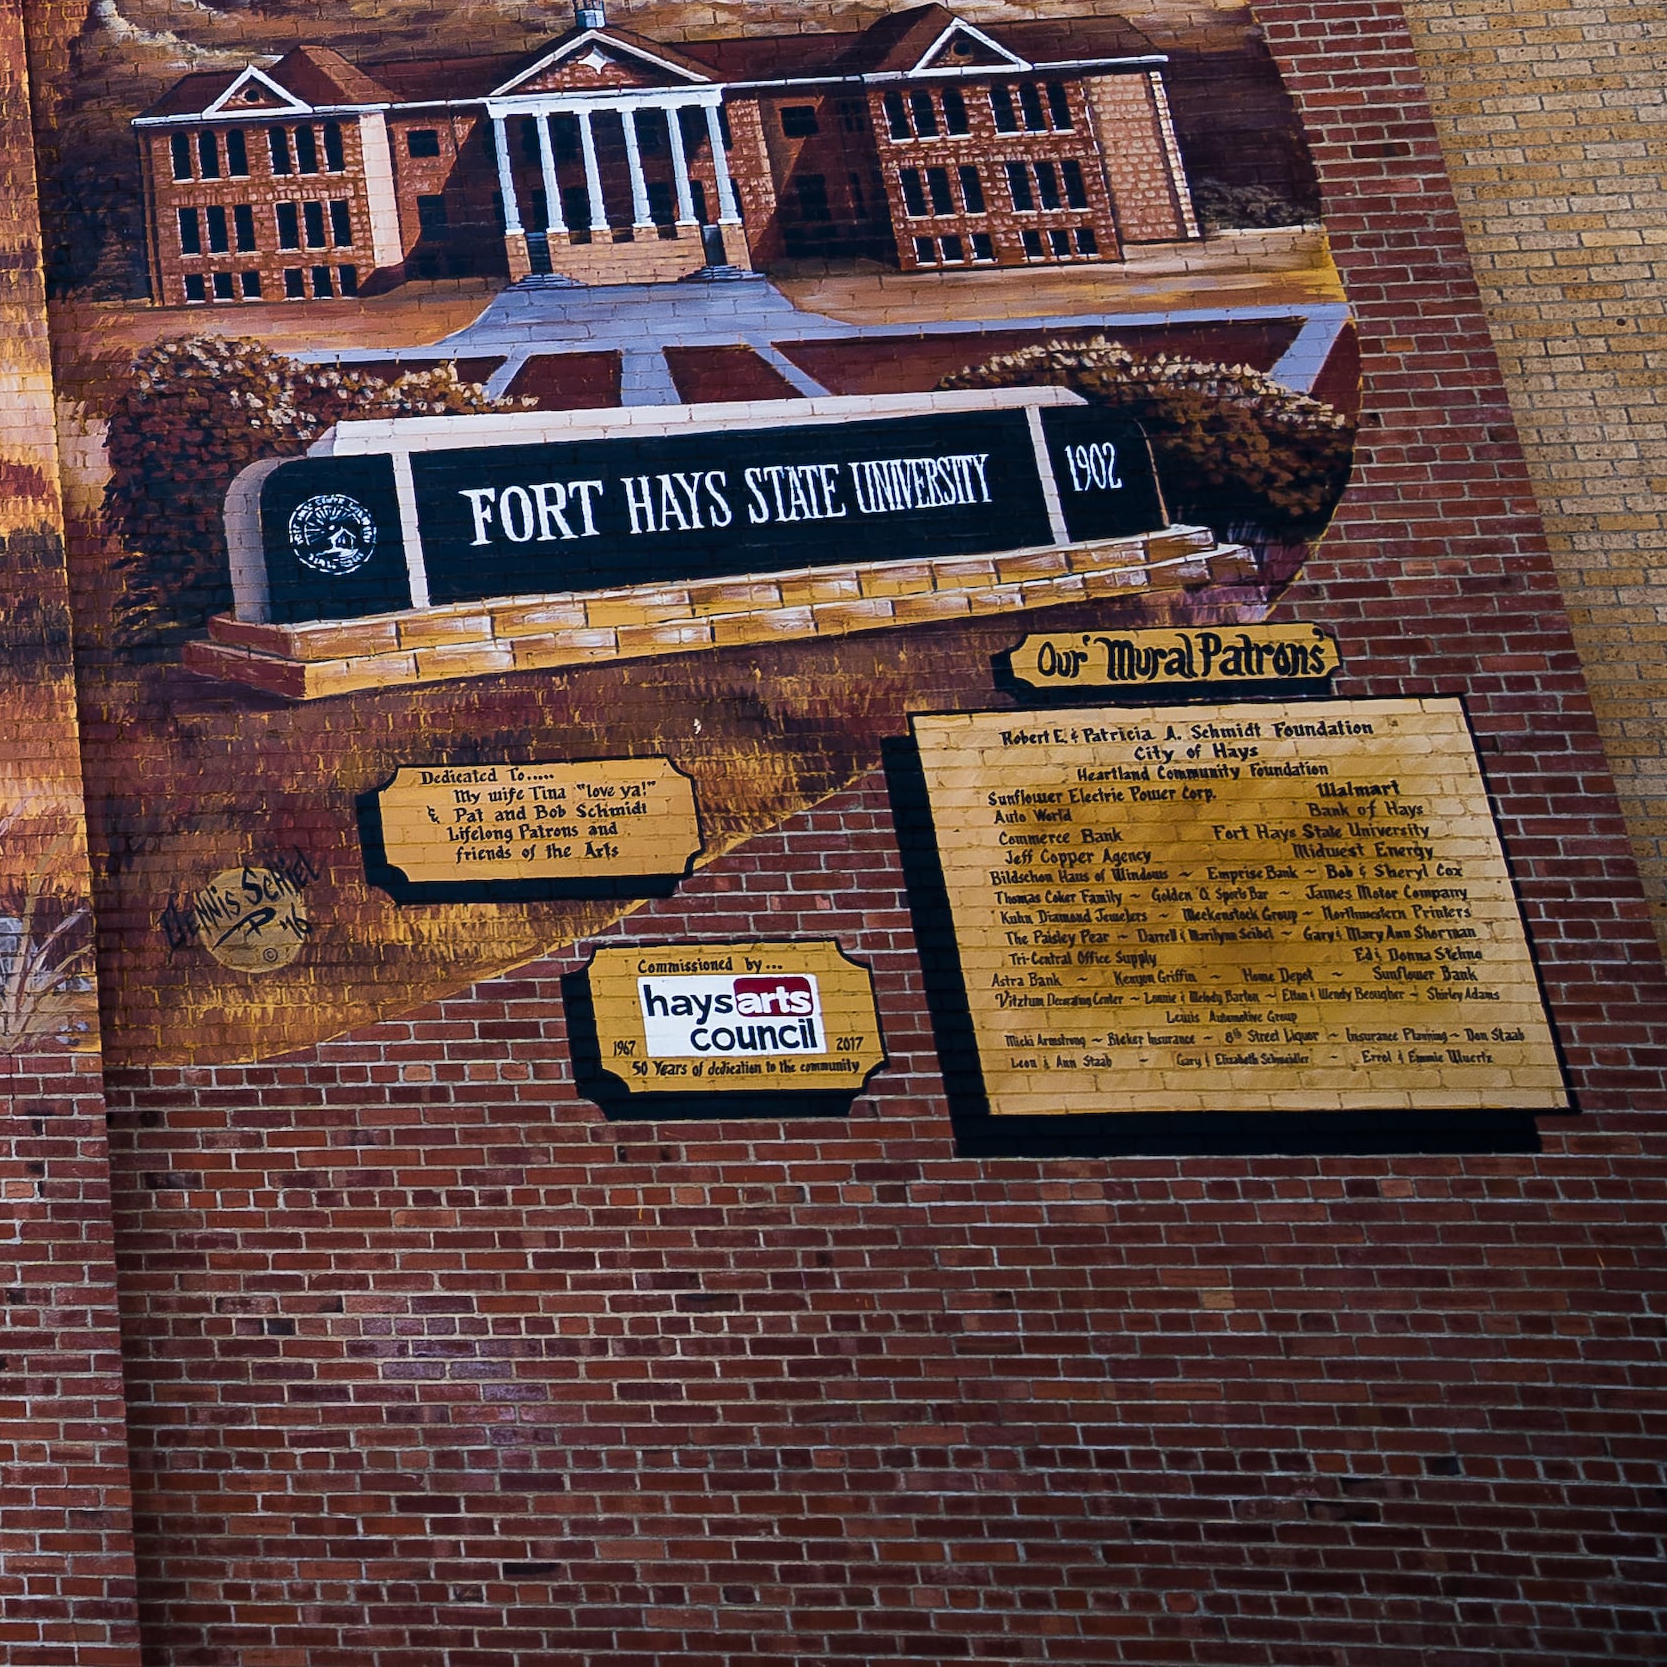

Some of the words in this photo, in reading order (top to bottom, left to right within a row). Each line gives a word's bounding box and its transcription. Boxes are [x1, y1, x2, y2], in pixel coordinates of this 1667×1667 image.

[1063, 441, 1123, 494] 1902
[460, 478, 604, 548] FORT
[618, 471, 733, 536] HAYS
[743, 466, 848, 524] STATE
[852, 453, 995, 515] UNIVERSITY
[1038, 641, 1089, 678] Our
[999, 730, 1050, 745] Robert
[1082, 727, 1156, 742] Patricia
[1163, 726, 1181, 741] A.
[1190, 723, 1261, 739] Schmidt
[1271, 721, 1374, 738] Foundation
[1134, 746, 1174, 764] City
[1187, 744, 1202, 758] of
[1213, 743, 1258, 761] Hays
[419, 769, 498, 785] Dedicated
[1078, 767, 1150, 782] Heartland
[1157, 765, 1239, 780] Community
[1250, 763, 1329, 778] Foundation
[453, 789, 481, 804] My
[488, 788, 524, 805] wife
[530, 786, 567, 800] Tina
[988, 789, 1064, 806] Sunflower
[1068, 788, 1124, 804] Electric
[1128, 786, 1176, 802] Power
[1182, 786, 1216, 803] Corp.
[1316, 781, 1400, 797] Walmart
[453, 807, 484, 823] Pat
[495, 805, 527, 821] and
[535, 805, 566, 819] Bob
[576, 801, 647, 818] Schmidt
[994, 810, 1026, 824] Auto
[1033, 809, 1072, 822] World
[1307, 802, 1349, 817] Bank
[1357, 800, 1377, 819] of
[1385, 802, 1424, 819] Hays
[446, 825, 513, 844] Lifelong
[518, 823, 579, 840] Patrons
[588, 822, 618, 835] and
[998, 832, 1070, 845] Commerce
[1081, 827, 1123, 843] Bank
[1211, 825, 1249, 840] Fort
[1254, 824, 1296, 842] Hays
[1302, 824, 1342, 839] State
[1348, 823, 1430, 838] University
[455, 844, 511, 864] friends
[521, 844, 537, 861] of
[546, 842, 572, 857] the
[585, 841, 619, 860] Arts
[1005, 849, 1033, 865] Jeff
[1040, 849, 1094, 868] Copper
[1102, 849, 1151, 867] Agency
[1292, 843, 1365, 859] Midwest
[1374, 841, 1433, 861] Energy
[1095, 869, 1105, 882] of
[1111, 867, 1168, 882] Windows
[1208, 866, 1263, 883] Emprise
[1266, 865, 1298, 879] Bank
[1325, 864, 1353, 879] Bob
[1374, 864, 1428, 881] Sheryl
[1436, 863, 1463, 877] Cox
[994, 891, 1040, 905] Thomas
[1079, 889, 1122, 906] Family
[1151, 887, 1192, 904] Golden
[1249, 886, 1268, 900] Bar
[1305, 885, 1352, 900] James
[1356, 885, 1398, 900] Motor
[1403, 884, 1467, 901] Company
[1001, 911, 1033, 925] Kuhn
[1036, 909, 1091, 924] Diamond
[1095, 908, 1148, 923] Jewelers
[1262, 909, 1298, 923] Group
[1322, 908, 1406, 921] Northwestern
[1411, 904, 1472, 919] Printers
[1005, 931, 1029, 946] The
[1033, 930, 1075, 949] Paisley
[1081, 929, 1110, 944] Pear
[1303, 926, 1334, 943] Gary
[1345, 925, 1383, 943] Mary
[1386, 925, 1410, 939] Ann
[638, 957, 733, 973] Commissioned
[1008, 952, 1072, 966] Tri-Central
[1077, 952, 1111, 965] Office
[1115, 950, 1157, 969] Supply
[1353, 948, 1374, 963] Ed
[1387, 948, 1432, 962] Donna
[991, 973, 1024, 987] Astra
[1028, 972, 1062, 987] Bank
[1158, 970, 1197, 983] Griffin
[1242, 969, 1275, 982] Home
[1278, 968, 1314, 984] Depot
[1372, 966, 1435, 981] Sunflower
[1440, 965, 1478, 981] Bank
[643, 985, 734, 1025] hays
[736, 986, 812, 1014] arts
[1093, 993, 1124, 1005] Center
[1465, 987, 1499, 1000] Adams
[1267, 1011, 1297, 1023] Group
[690, 1018, 818, 1051] council
[836, 1037, 864, 1051] 2017
[1147, 1032, 1195, 1045] Insurance
[1247, 1030, 1280, 1043] Street
[1283, 1028, 1319, 1045] Liquor
[1346, 1028, 1399, 1042] Insurance
[1464, 1029, 1489, 1042] Don
[614, 1041, 636, 1057] 1967
[632, 1061, 648, 1076] 50
[652, 1060, 687, 1076] Years
[692, 1061, 705, 1076] of
[708, 1060, 762, 1076] dedication
[766, 1060, 776, 1073] to
[779, 1060, 796, 1073] the
[800, 1059, 860, 1073] community
[1056, 1055, 1077, 1068] Ann
[1176, 1056, 1202, 1069] Gary
[1362, 1051, 1392, 1063] Errol
